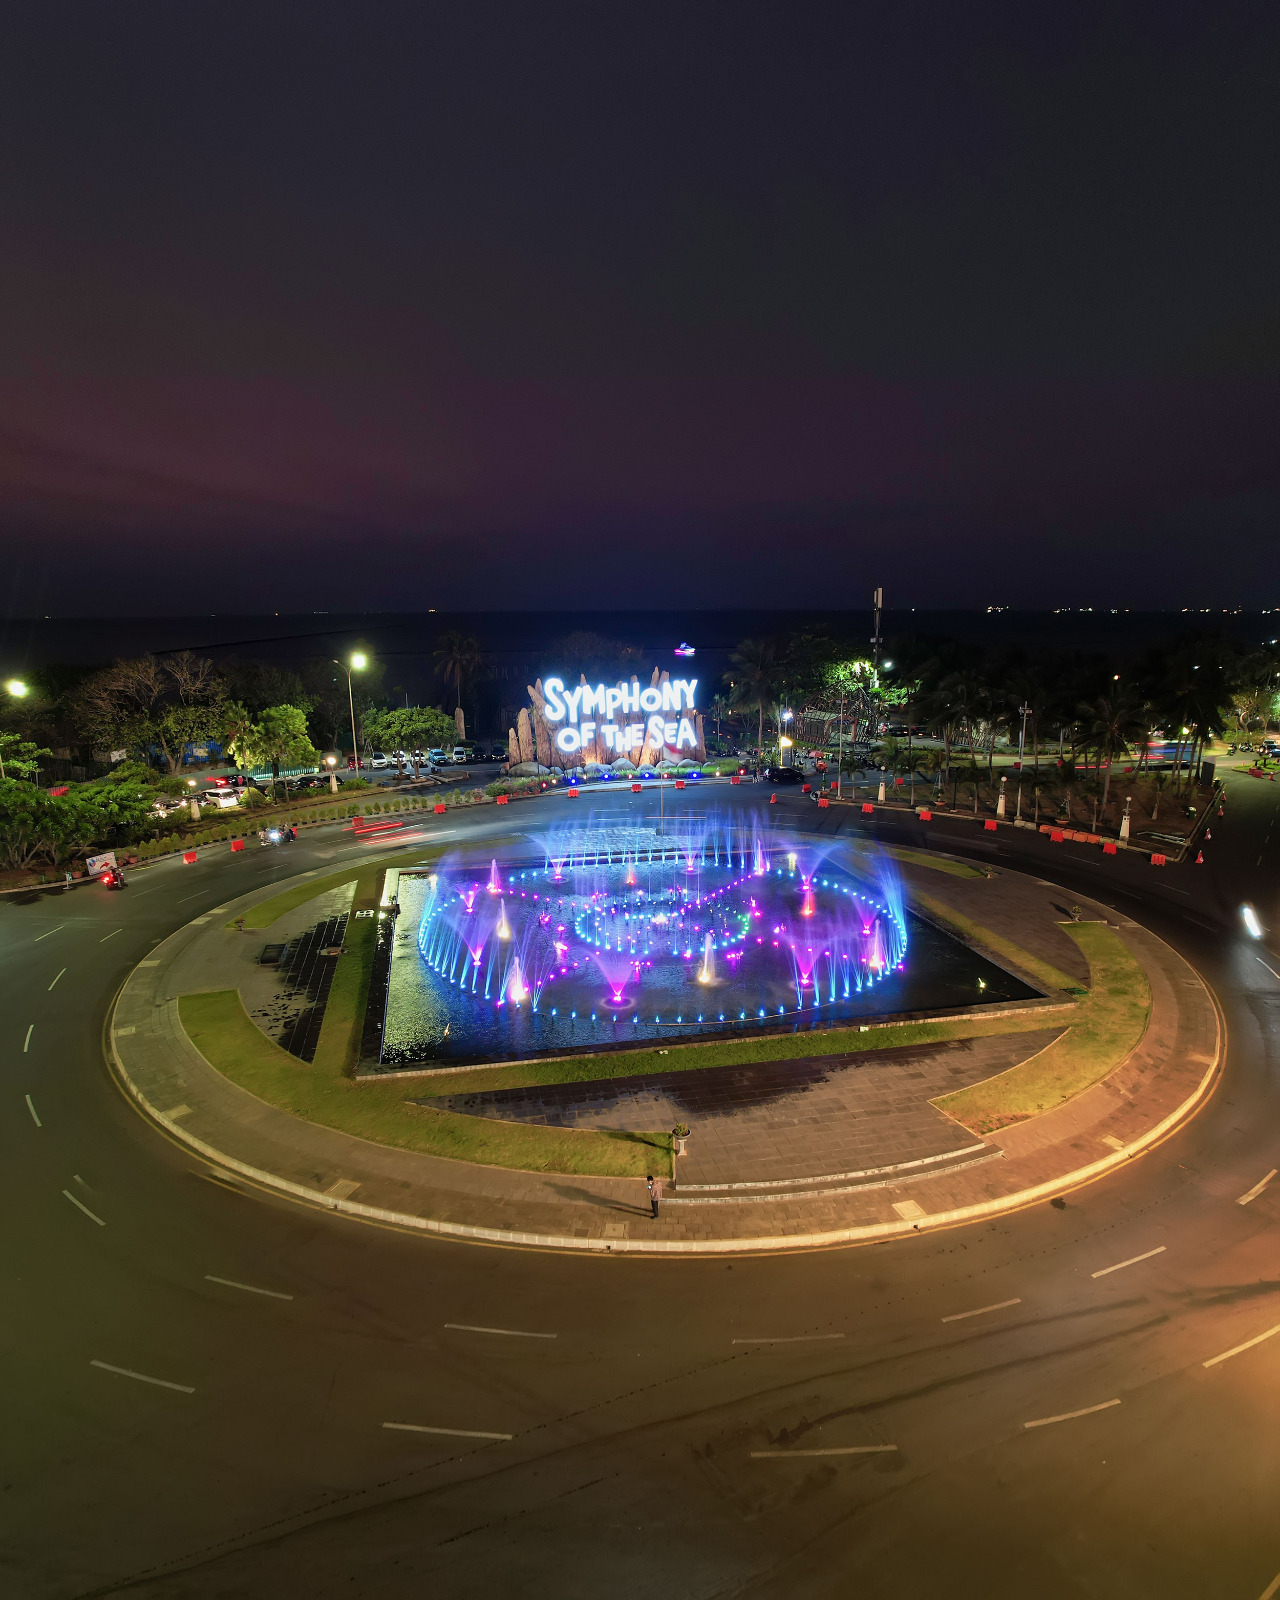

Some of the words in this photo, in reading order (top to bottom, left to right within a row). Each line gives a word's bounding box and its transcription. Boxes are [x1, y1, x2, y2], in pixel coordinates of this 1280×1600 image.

[544, 678, 698, 722] SYMPHONY
[557, 722, 596, 752] OF
[601, 723, 645, 752] THE
[648, 715, 697, 749] SEA
